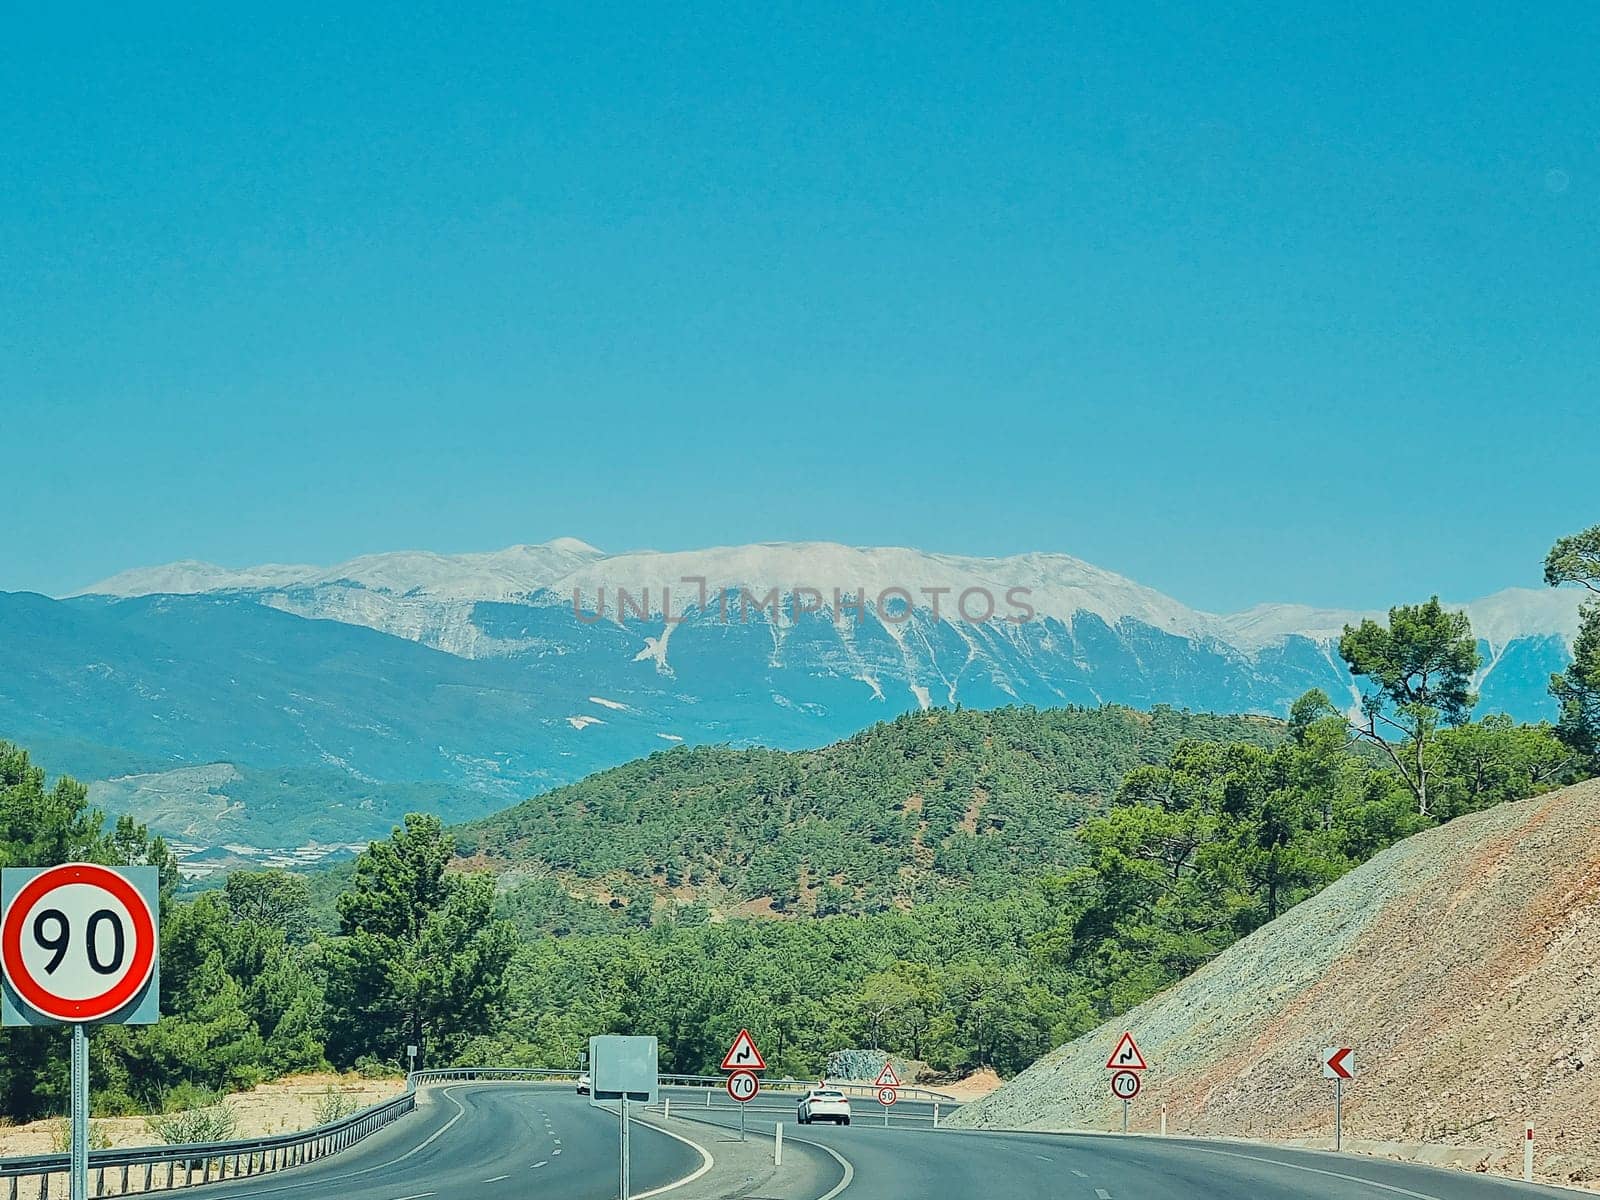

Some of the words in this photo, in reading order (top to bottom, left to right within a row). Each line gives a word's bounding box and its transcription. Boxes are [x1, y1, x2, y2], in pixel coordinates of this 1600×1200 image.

[33, 909, 124, 975] 90
[734, 1079, 752, 1093] 70
[1118, 1078, 1135, 1092] 70
[881, 1092, 893, 1101] 50
